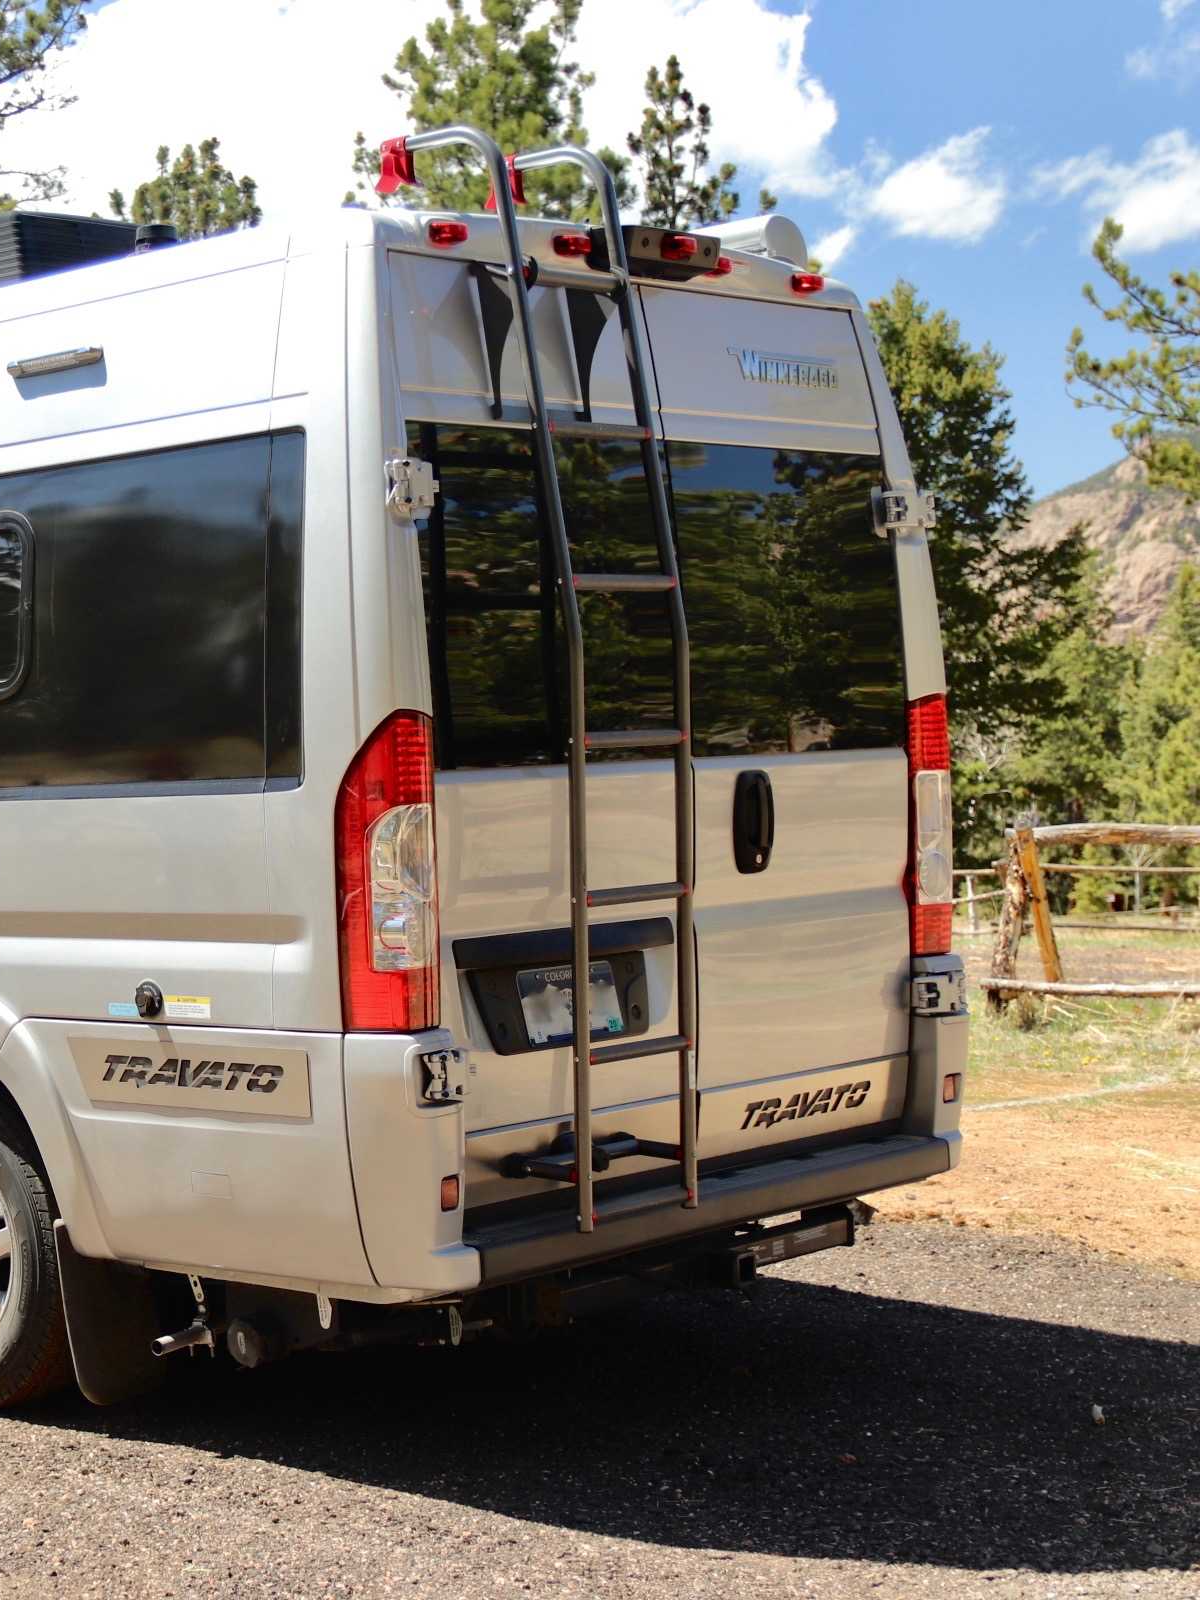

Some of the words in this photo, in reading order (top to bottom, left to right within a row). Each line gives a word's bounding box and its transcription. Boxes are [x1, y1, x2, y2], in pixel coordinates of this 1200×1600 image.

[544, 968, 573, 982] COLOR
[102, 1054, 284, 1094] TRAVATO
[740, 1080, 871, 1130] TRAVATO
